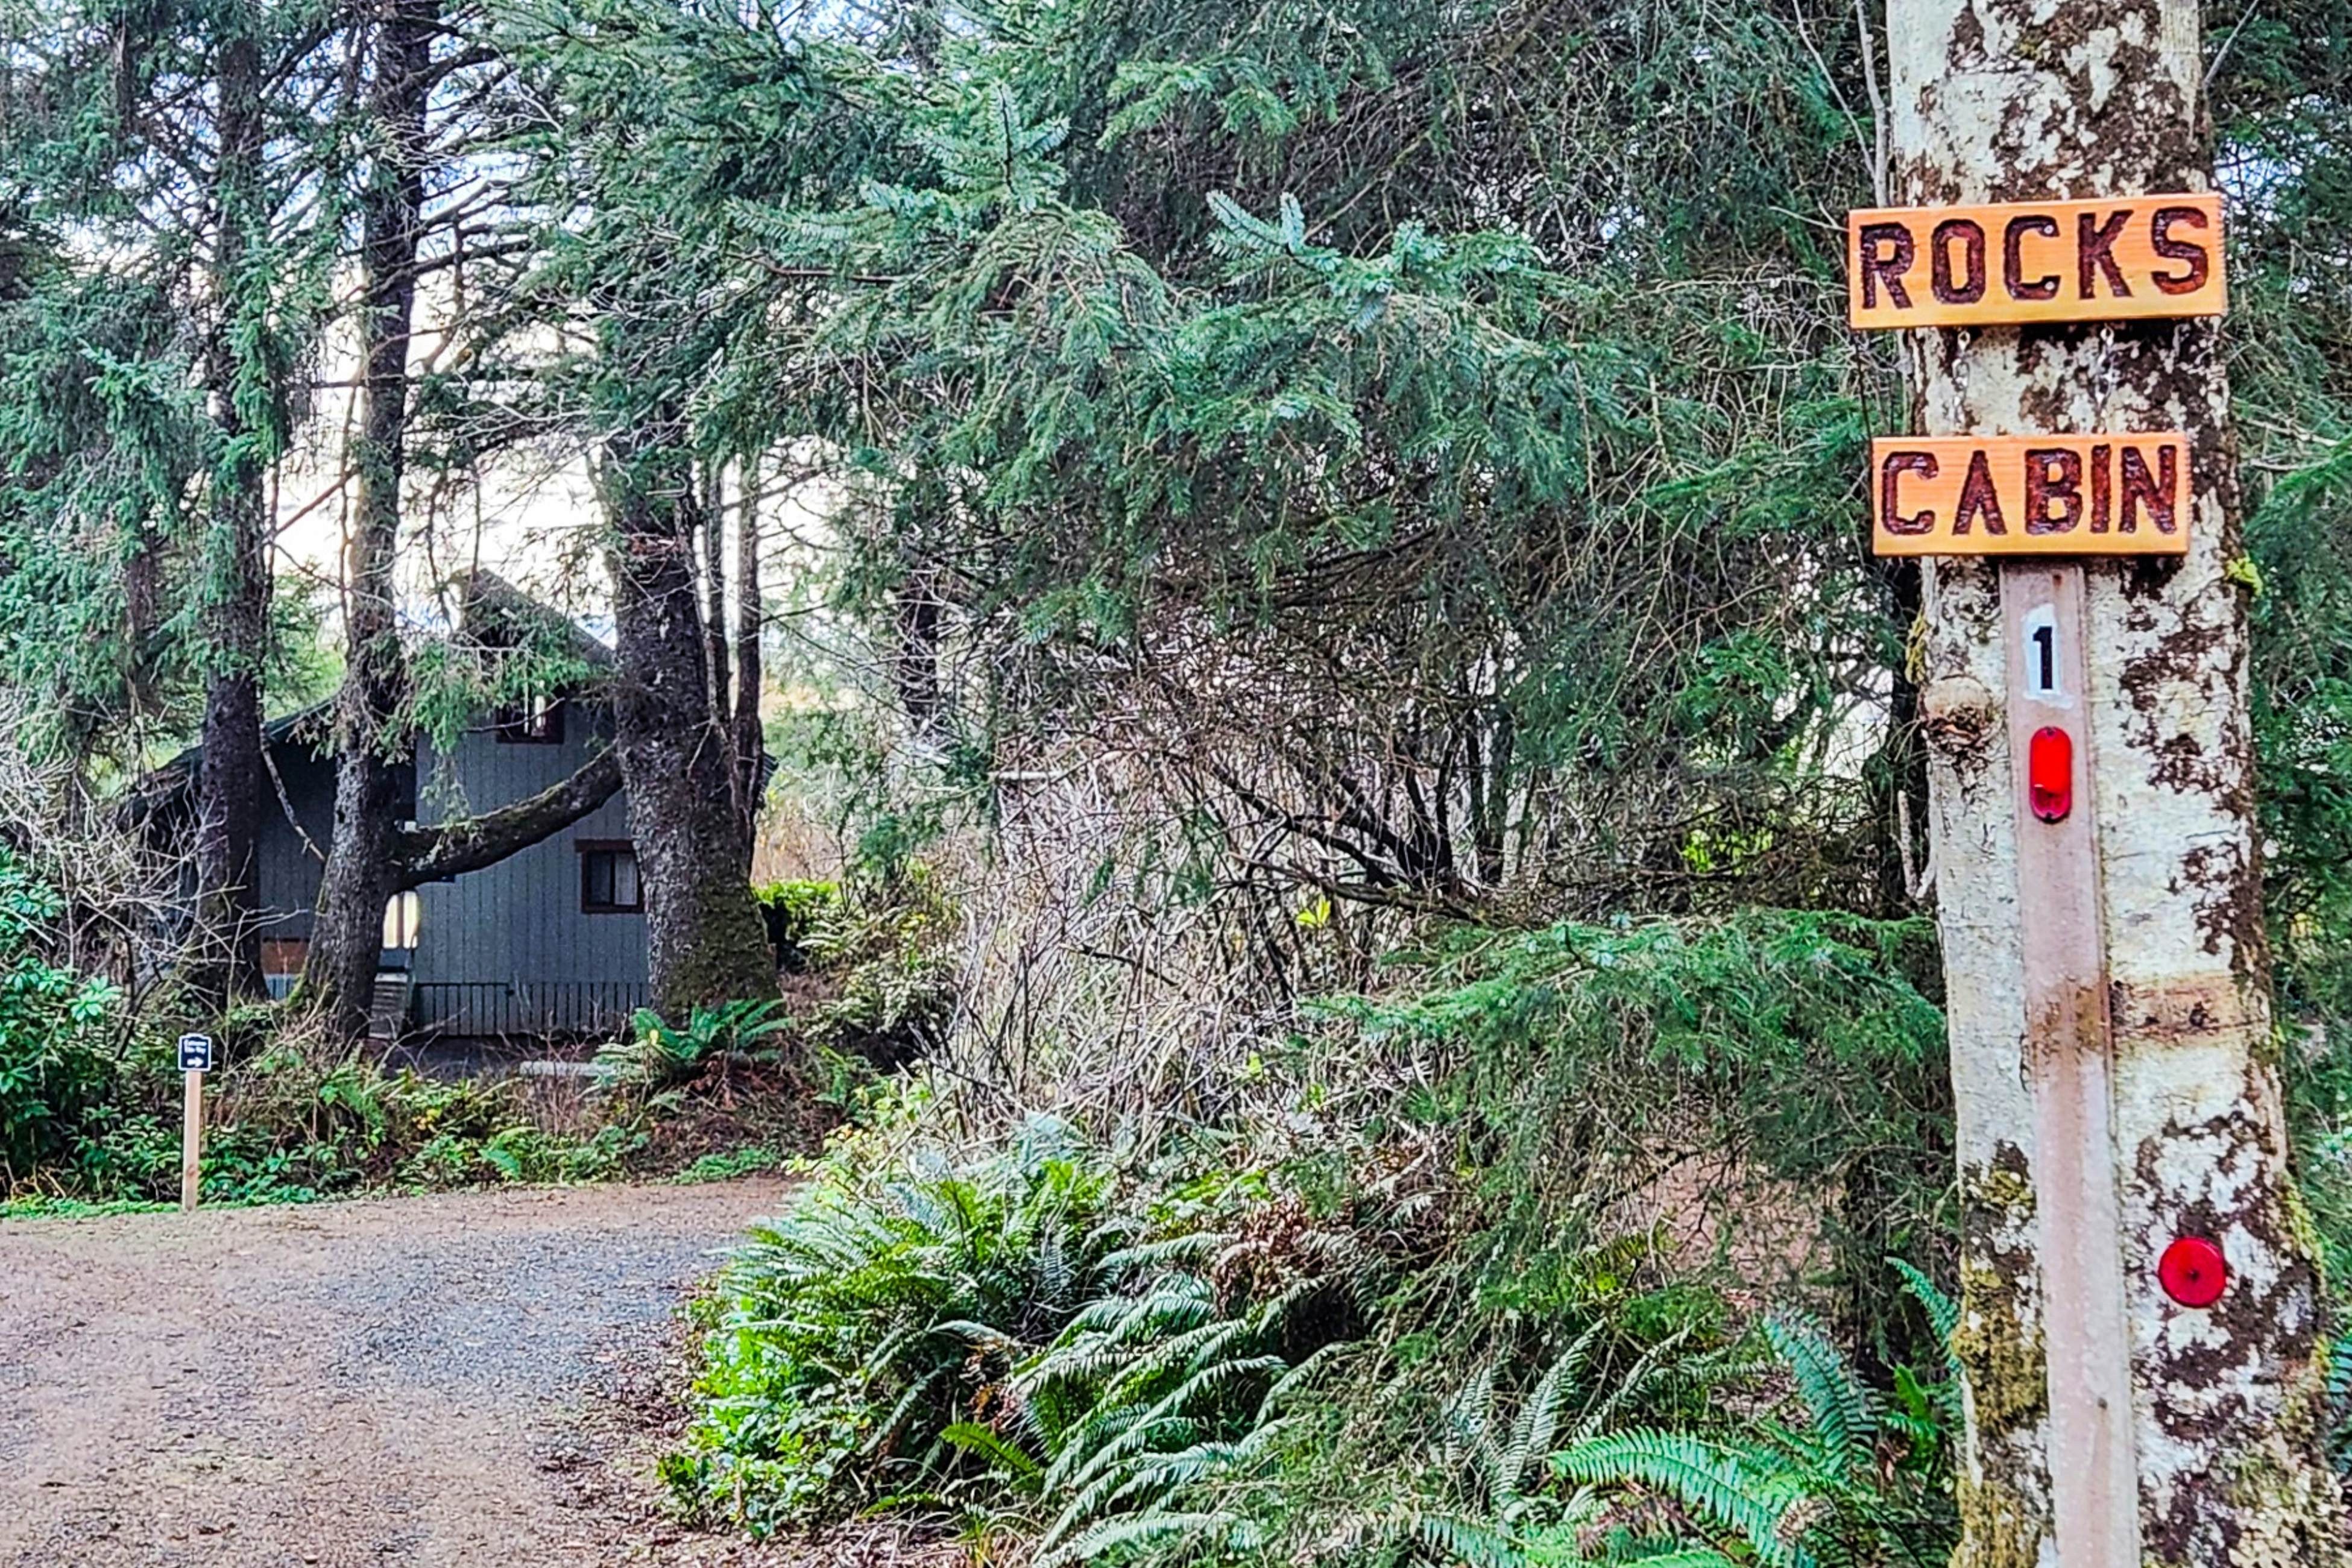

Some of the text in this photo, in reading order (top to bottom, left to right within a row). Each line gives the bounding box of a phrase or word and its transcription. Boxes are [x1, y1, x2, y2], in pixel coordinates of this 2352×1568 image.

[1859, 206, 2209, 310] ROCKS
[1881, 443, 2178, 536] CABIN
[2032, 626, 2054, 690] 1
